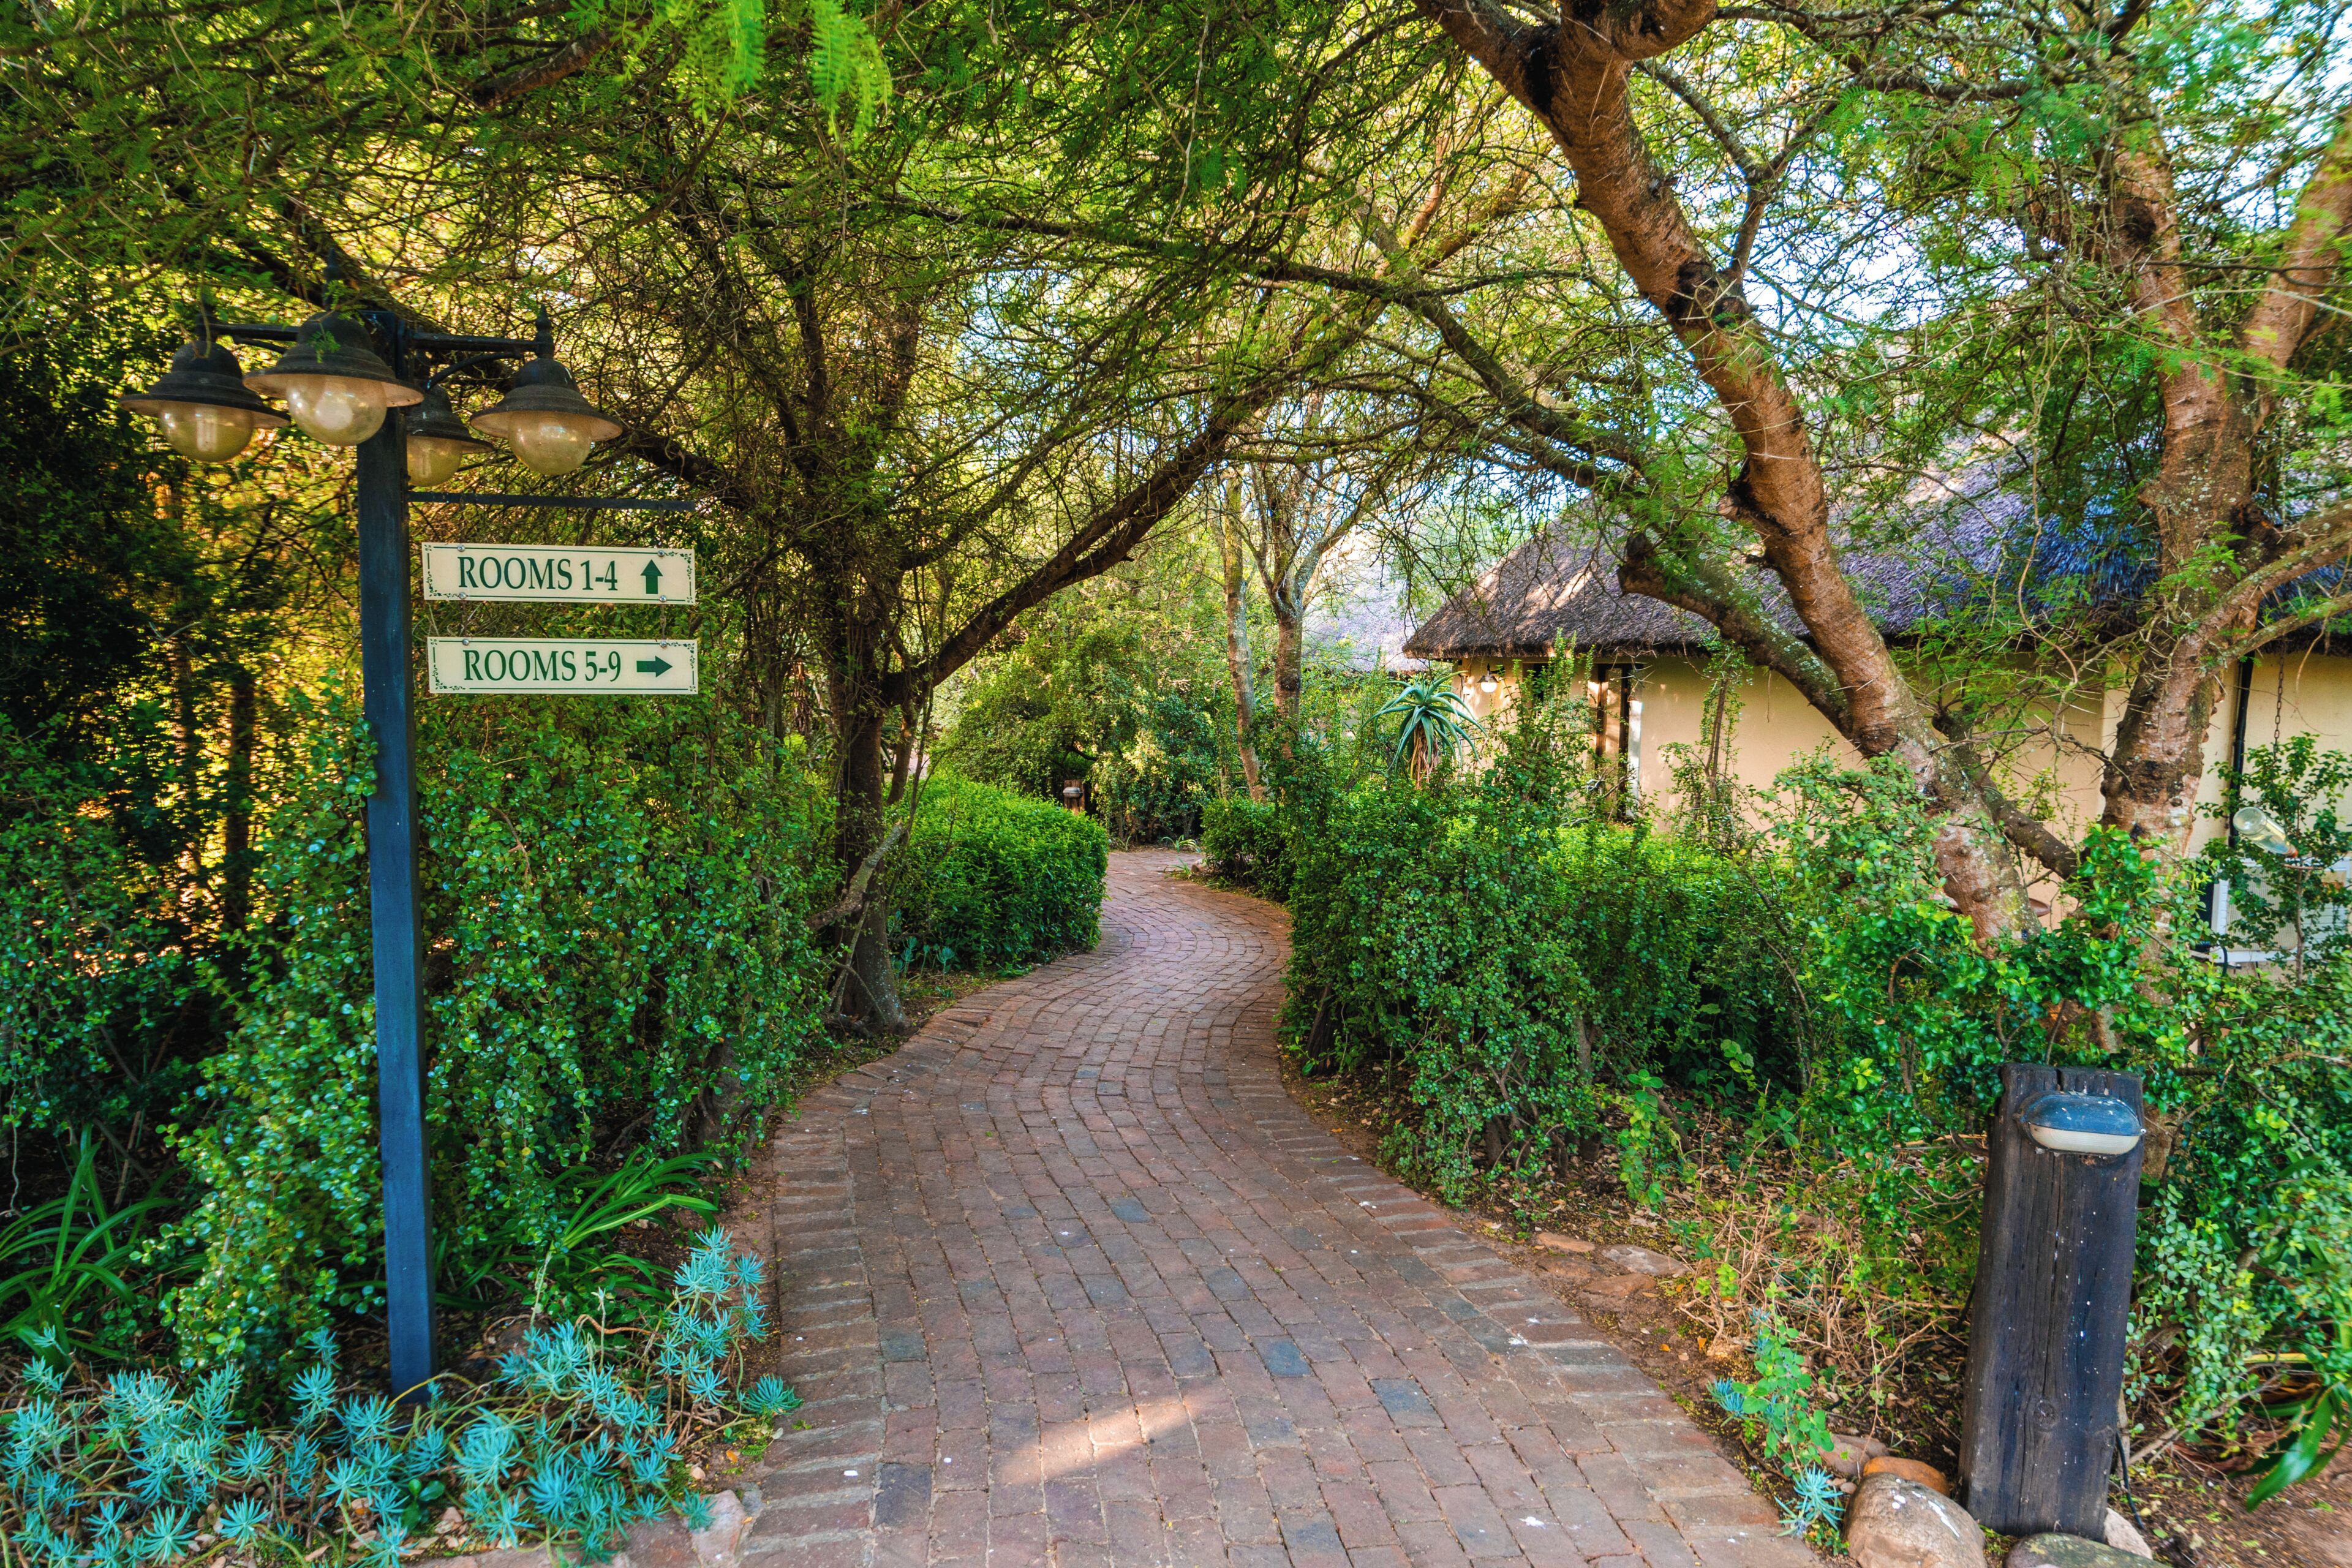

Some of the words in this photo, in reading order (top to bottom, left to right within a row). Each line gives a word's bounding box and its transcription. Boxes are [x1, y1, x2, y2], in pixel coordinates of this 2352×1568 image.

[458, 556, 573, 590] ROOMS
[580, 560, 618, 591] 1-4
[463, 650, 576, 682] ROOMS
[585, 650, 621, 682] 5-9
